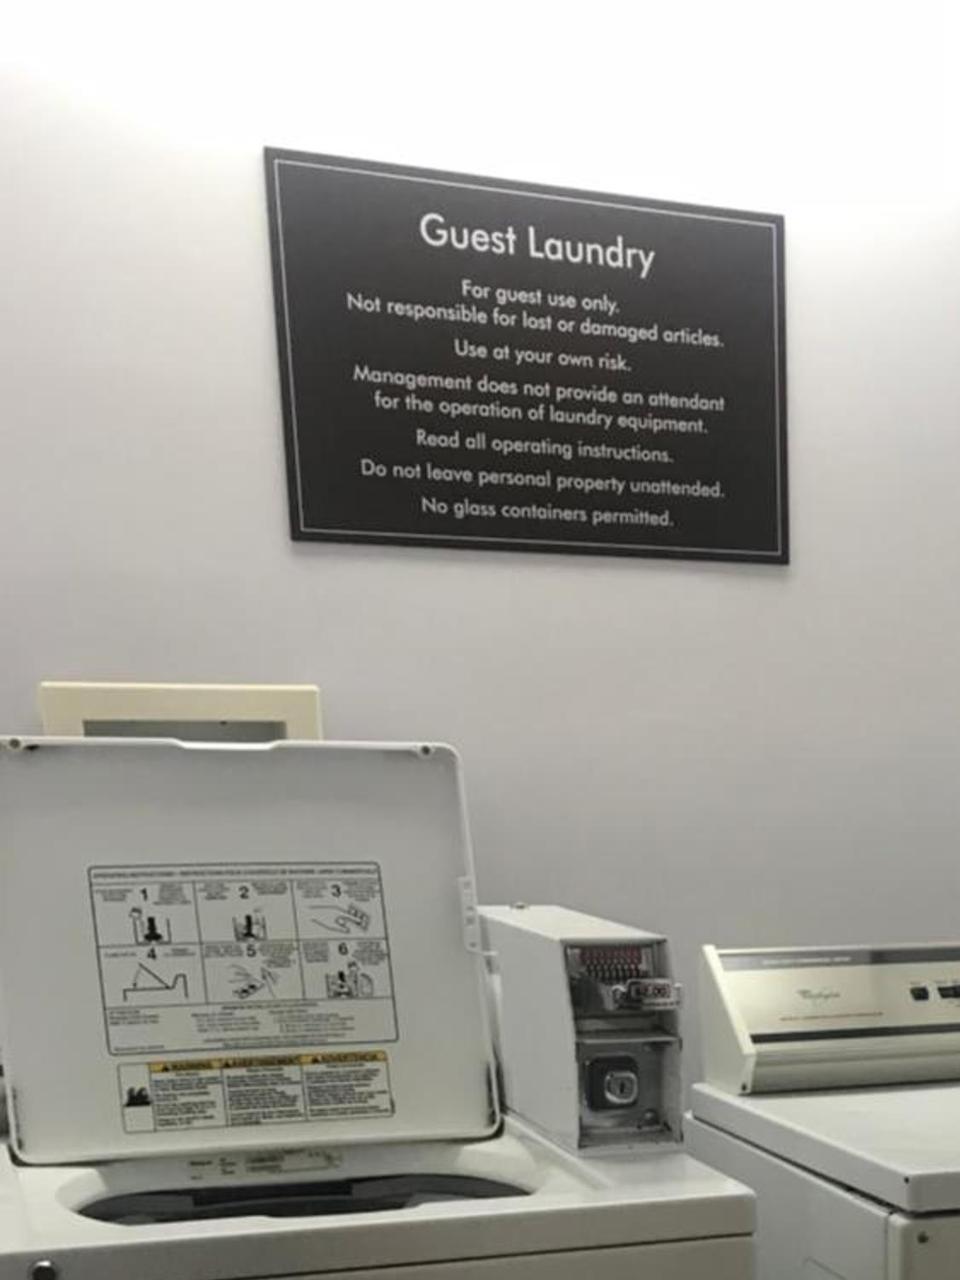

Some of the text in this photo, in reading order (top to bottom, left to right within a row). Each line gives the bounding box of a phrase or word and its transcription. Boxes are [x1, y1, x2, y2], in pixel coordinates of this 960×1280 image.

[420, 213, 655, 279] Guest Laundry
[462, 279, 620, 316] For guest use only.
[347, 292, 725, 348] Not responsible for lost or damaged articles.
[454, 339, 632, 372] Use at your own risk.
[353, 364, 725, 412] Management does not provide an attendant
[374, 390, 708, 434] for the operation of laundry equipment.
[416, 428, 674, 463] Read all operating instructions.
[361, 458, 725, 499] Do not leave personal property unattended.
[422, 497, 674, 527] No glass containers permitted.
[141, 888, 148, 901] 1
[239, 886, 250, 900] 2
[331, 884, 342, 898] 3
[246, 944, 257, 958] 5
[338, 942, 349, 956] 6
